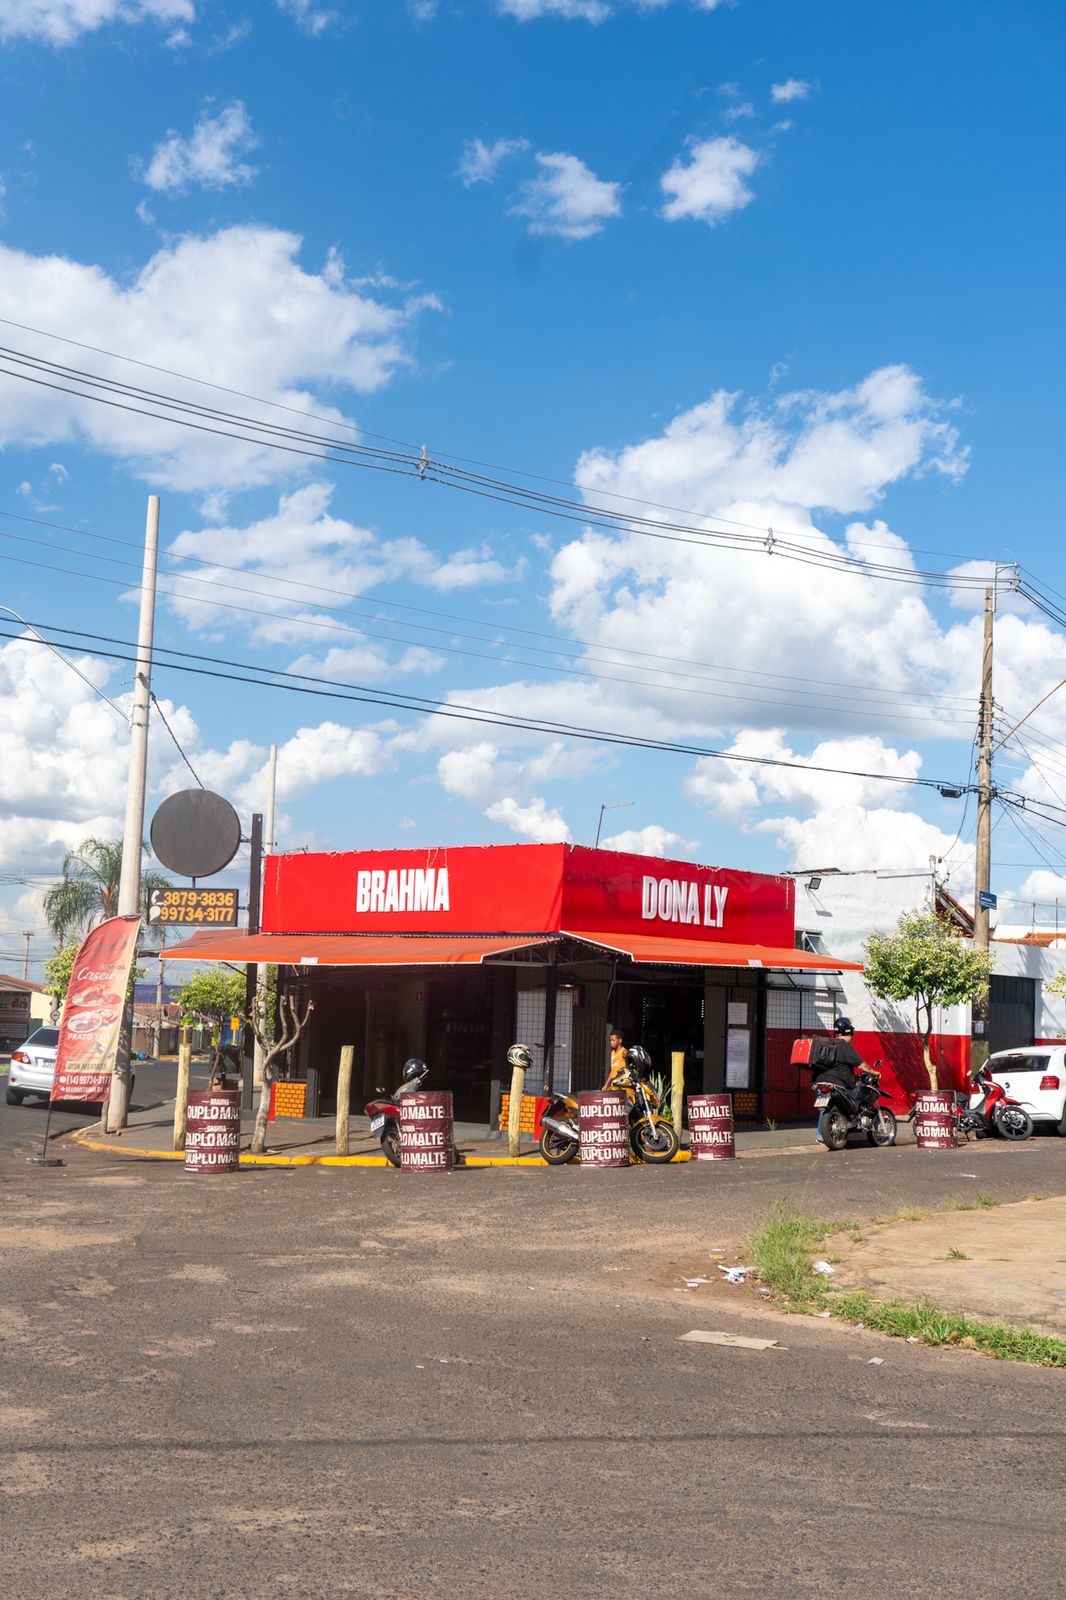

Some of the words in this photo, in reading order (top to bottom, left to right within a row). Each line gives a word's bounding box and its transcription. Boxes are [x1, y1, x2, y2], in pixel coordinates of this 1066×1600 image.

[356, 868, 450, 912] BRAHMA
[163, 891, 234, 906] 3879-3836
[642, 875, 700, 925] DONA
[703, 884, 729, 928] LY
[160, 906, 234, 922] 99734-3177
[67, 1033, 93, 1041] PRATO
[580, 1104, 612, 1118] DUPLO
[580, 1130, 612, 1144] DUPLO
